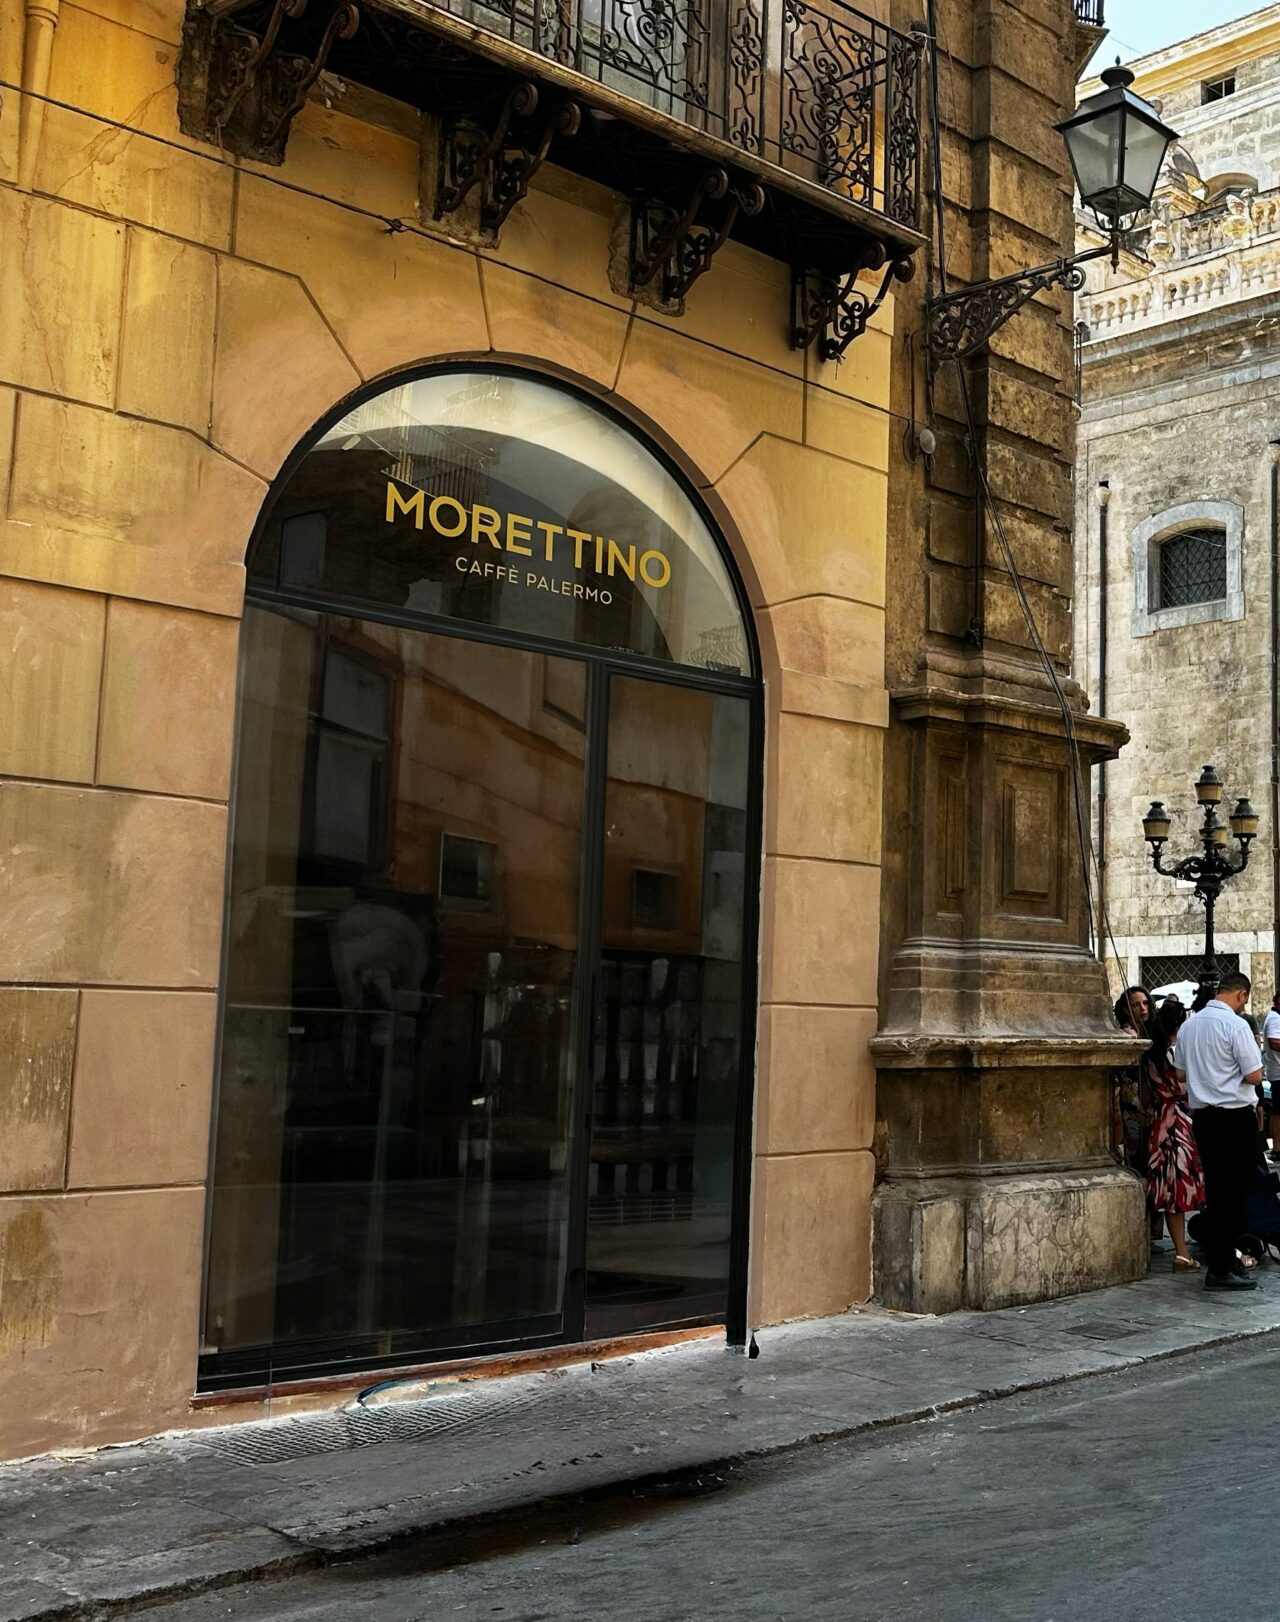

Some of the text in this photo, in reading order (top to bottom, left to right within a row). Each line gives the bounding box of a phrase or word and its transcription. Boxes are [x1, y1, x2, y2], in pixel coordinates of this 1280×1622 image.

[385, 481, 672, 588] MORETTINO
[455, 556, 613, 605] CAFFÈ PALERMO
